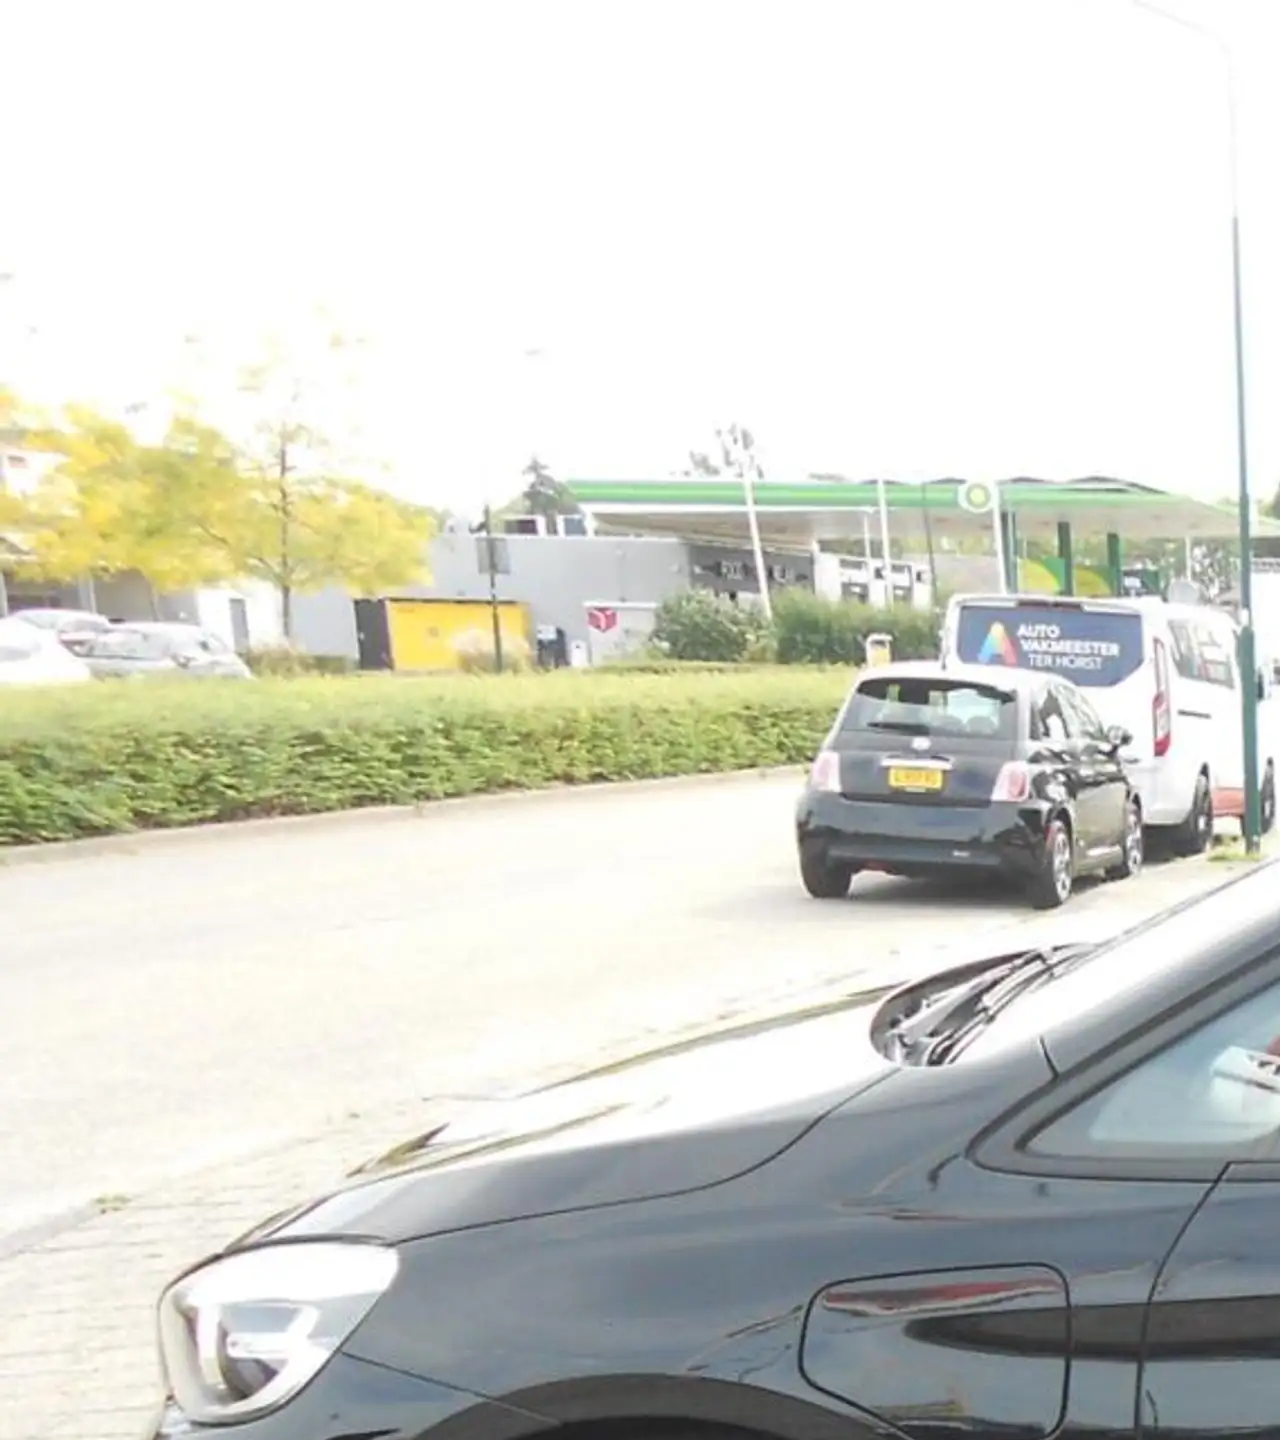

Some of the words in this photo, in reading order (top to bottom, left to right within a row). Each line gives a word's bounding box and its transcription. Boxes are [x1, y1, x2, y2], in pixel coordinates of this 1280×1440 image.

[1017, 623, 1060, 638] AUTO
[1020, 639, 1121, 657] VAKMEESTER
[1028, 653, 1052, 668] TER
[1055, 655, 1103, 671] HORST
